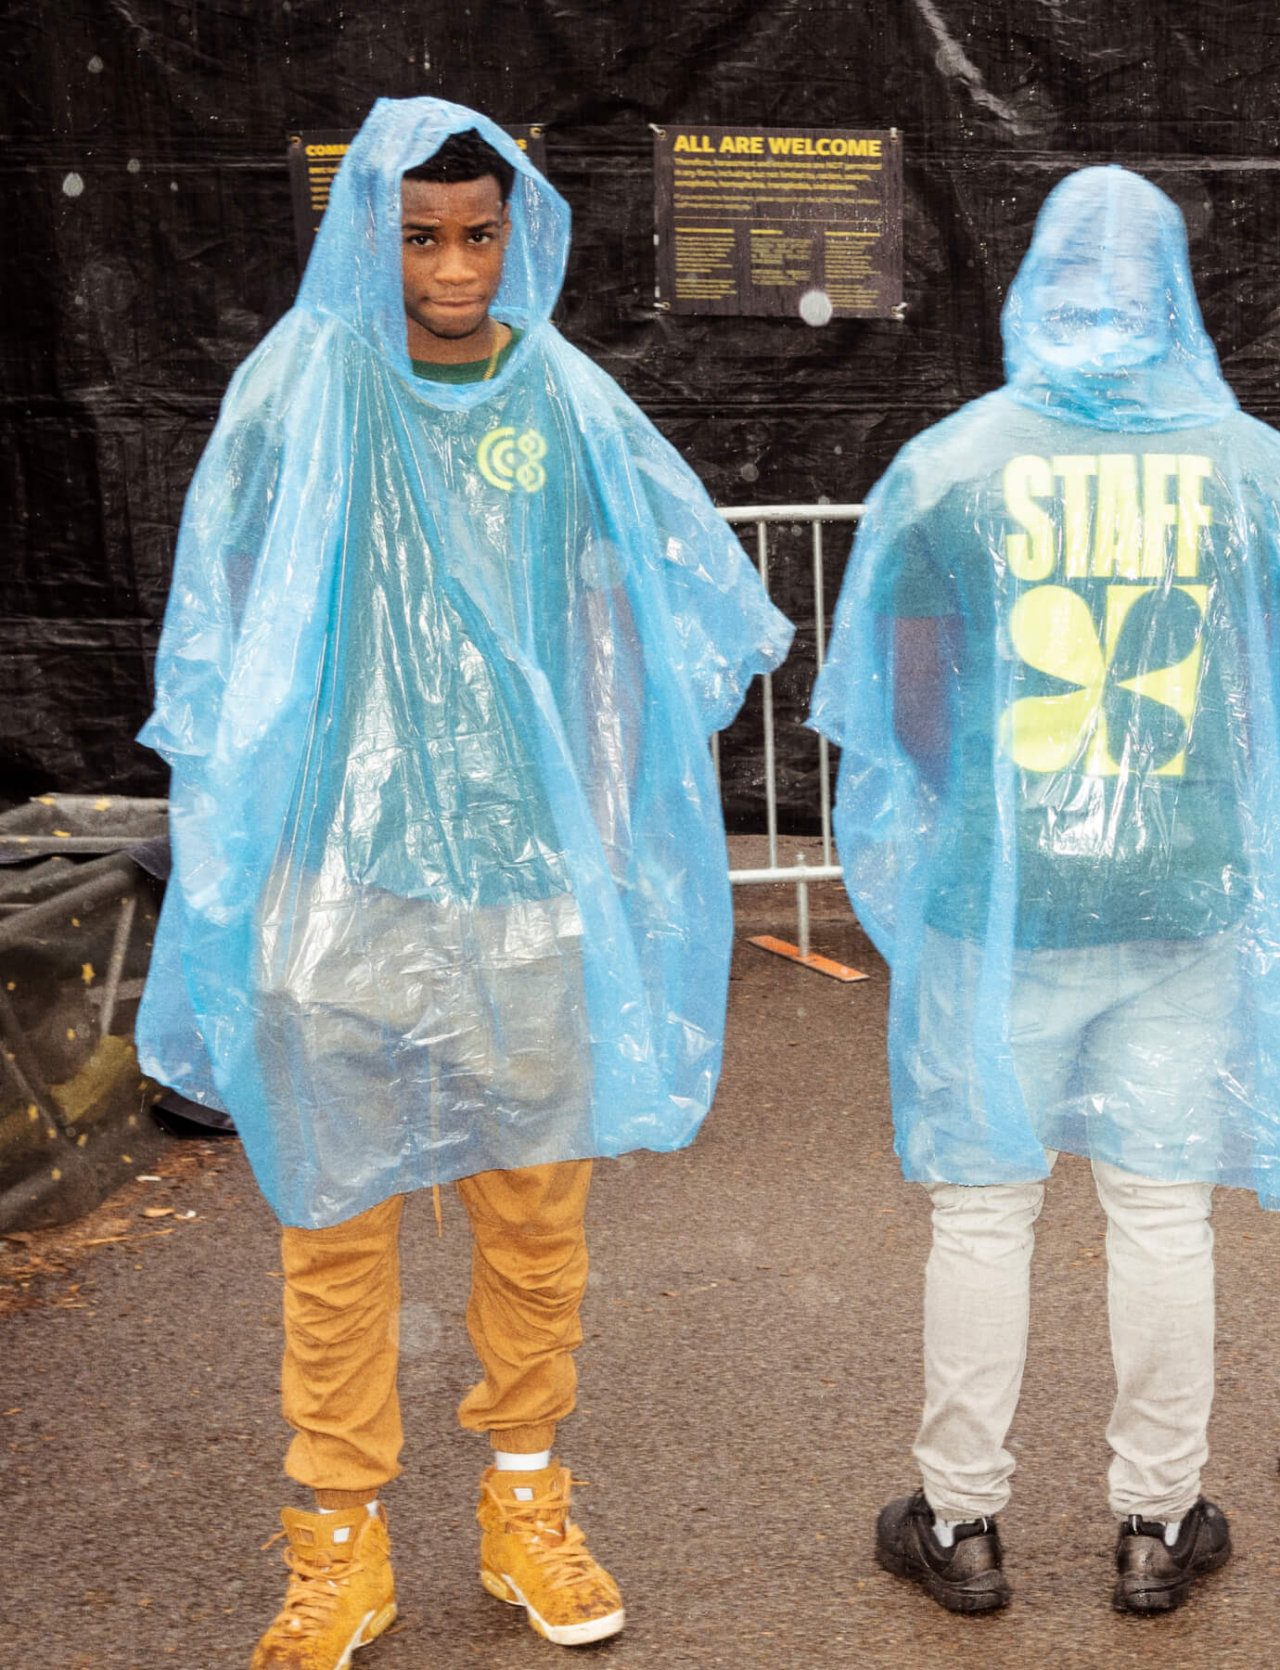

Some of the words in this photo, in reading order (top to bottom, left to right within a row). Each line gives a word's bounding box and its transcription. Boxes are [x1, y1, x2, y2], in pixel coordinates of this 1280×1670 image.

[674, 135, 715, 152] ALL
[719, 136, 763, 154] ARE
[768, 137, 882, 157] WELCOME
[1003, 454, 1213, 581] STAFF
